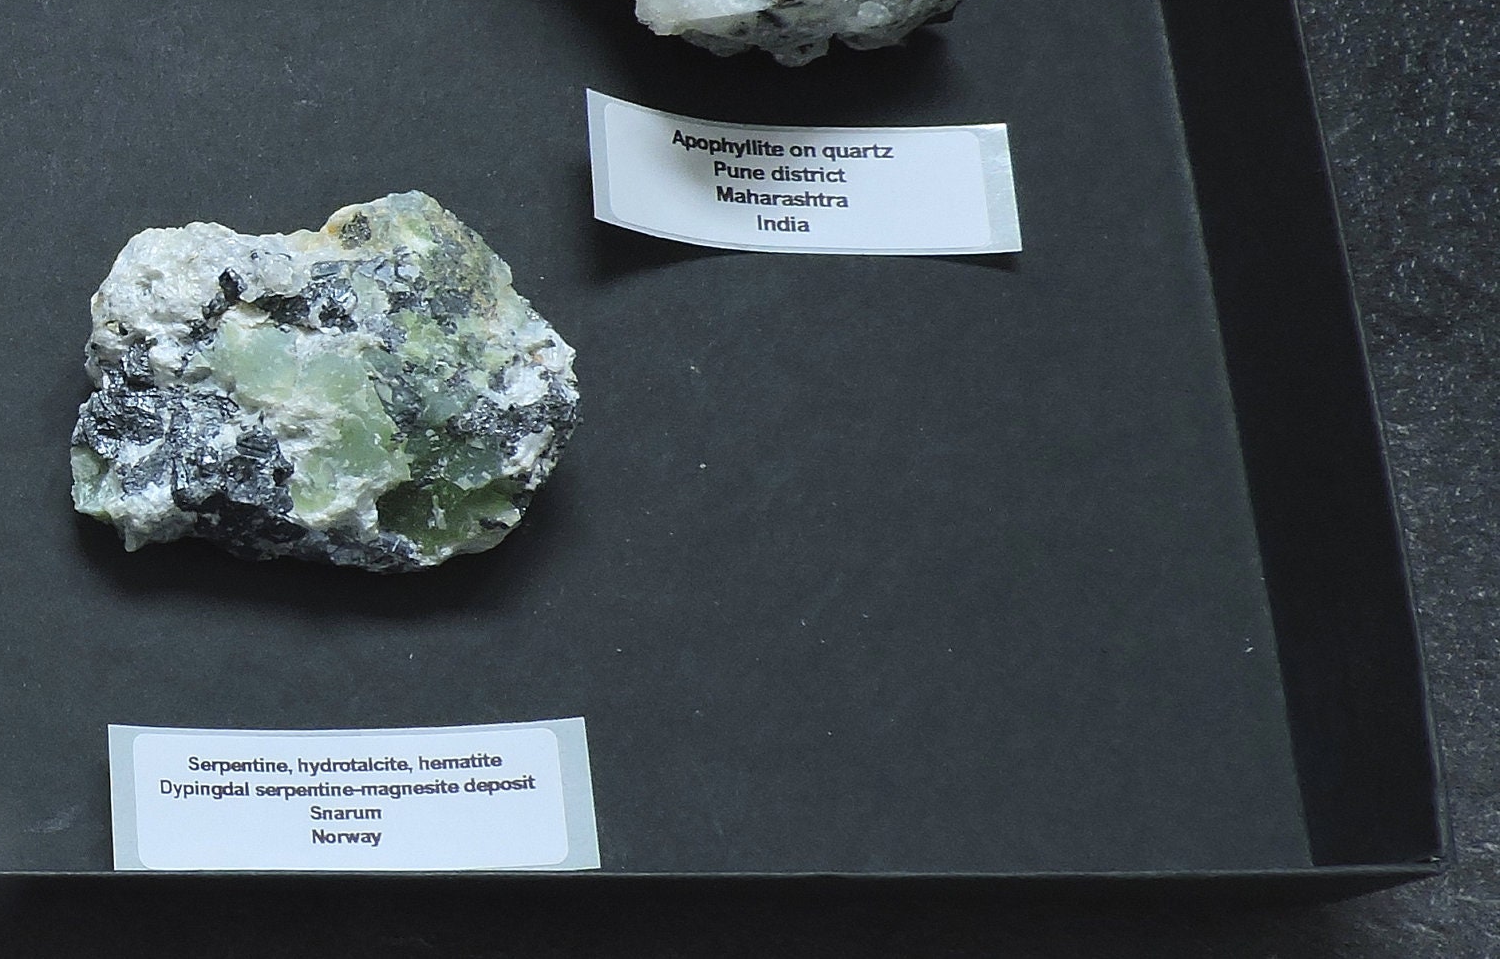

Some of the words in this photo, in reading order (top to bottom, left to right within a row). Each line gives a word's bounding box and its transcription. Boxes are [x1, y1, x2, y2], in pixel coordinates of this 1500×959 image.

[672, 130, 784, 158] Apophyllite
[790, 145, 816, 158] on
[822, 144, 894, 161] quartz
[714, 161, 765, 180] Pune
[771, 166, 847, 183] district
[716, 186, 848, 208] Maharashtra
[757, 214, 810, 232] India
[188, 757, 293, 775] Serpentine,
[298, 757, 413, 775] hydrotalcite,
[419, 753, 503, 770] hematite
[160, 780, 250, 797] Dypingdal
[255, 780, 460, 799] serpentine-magnesite
[464, 775, 536, 796] deposit
[310, 806, 382, 820] Snarum
[312, 830, 382, 846] Norway
